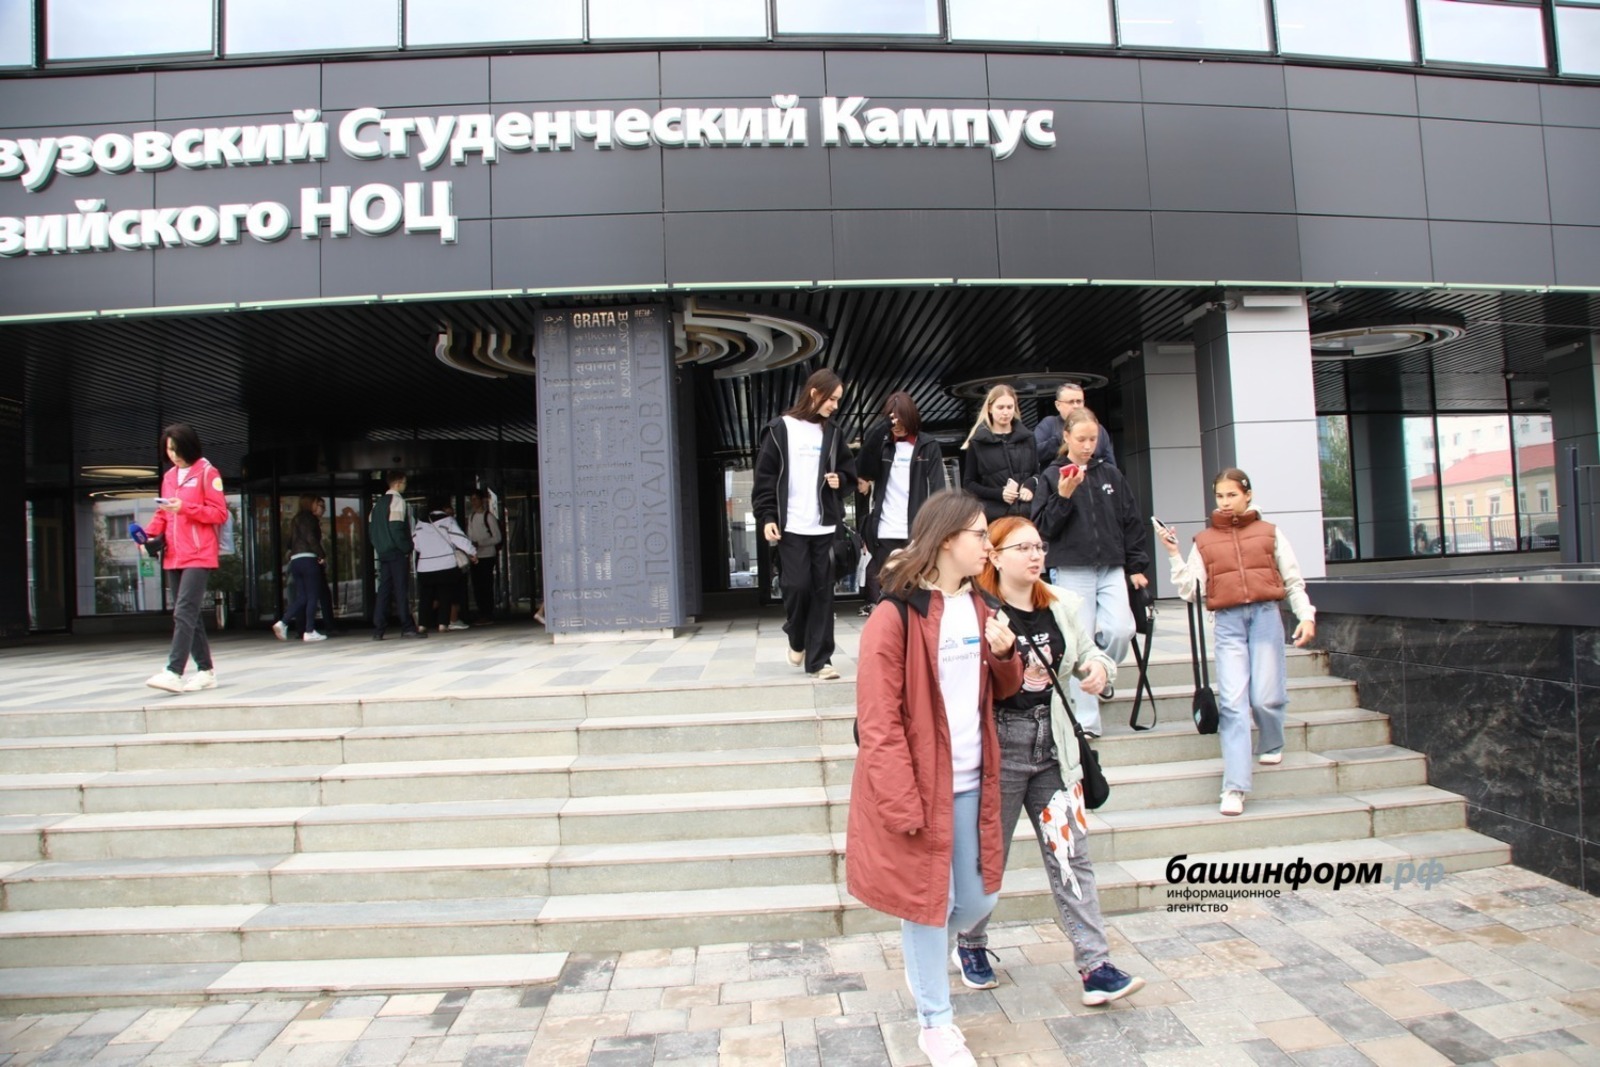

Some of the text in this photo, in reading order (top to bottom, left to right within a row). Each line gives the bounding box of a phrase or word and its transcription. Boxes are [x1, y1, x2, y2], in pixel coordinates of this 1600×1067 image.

[339, 94, 809, 171] Студенческий
[819, 96, 1057, 161] Кампус
[300, 180, 458, 244] НОЦ
[573, 311, 616, 328] GRATA
[637, 339, 670, 576] ПОЖАЛОВАТЬ
[612, 487, 644, 600] ДОБРО
